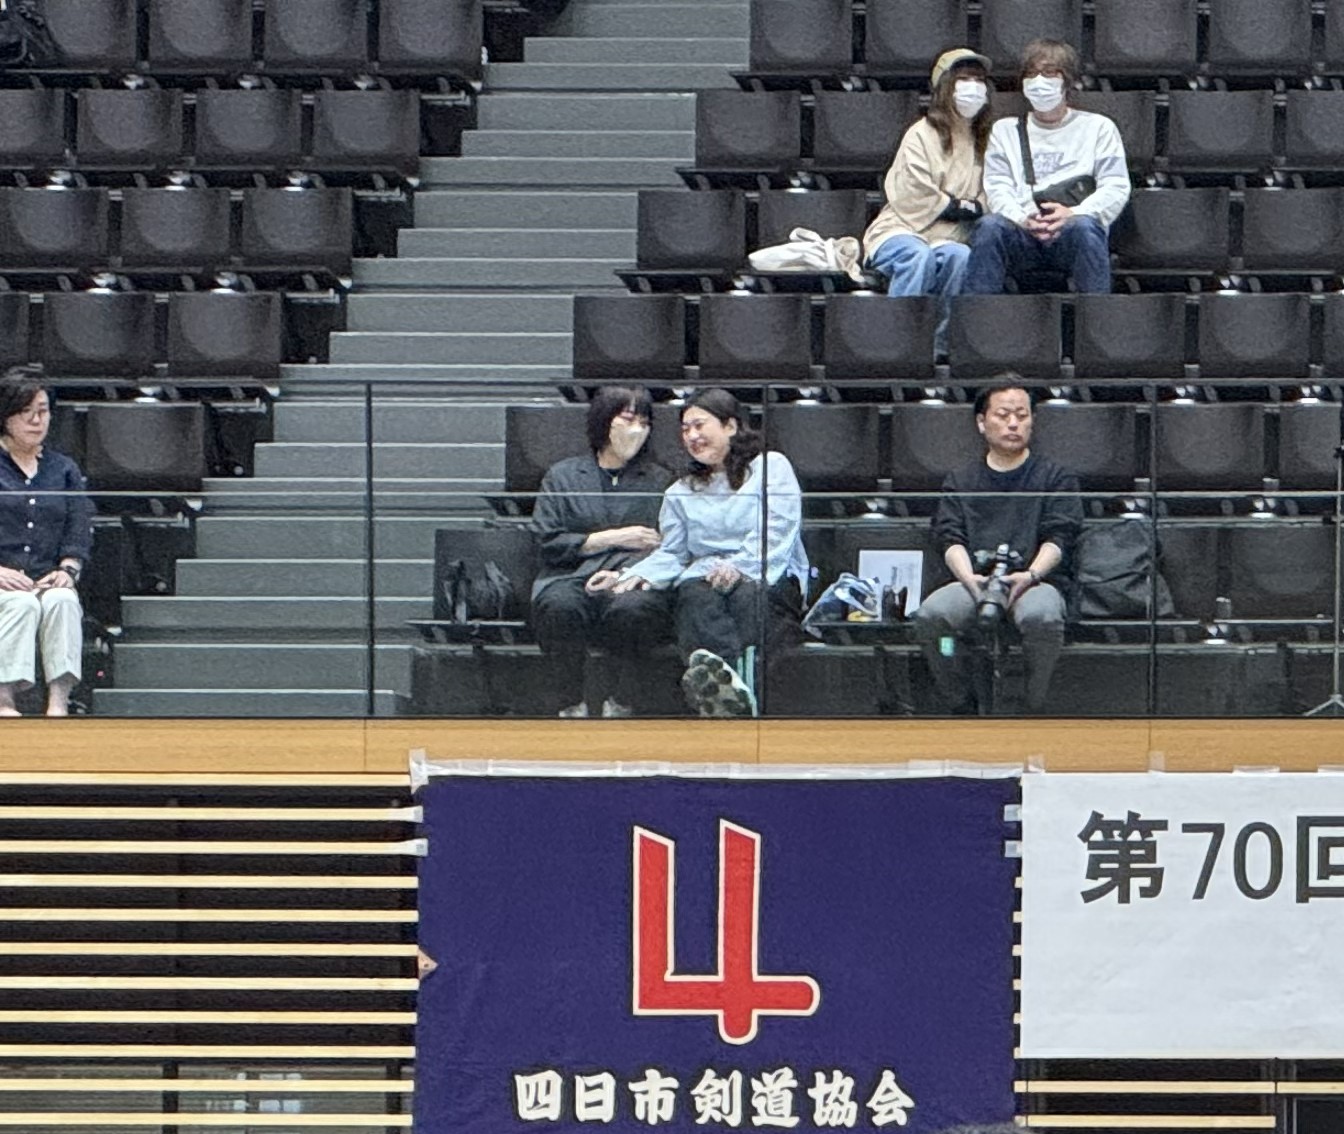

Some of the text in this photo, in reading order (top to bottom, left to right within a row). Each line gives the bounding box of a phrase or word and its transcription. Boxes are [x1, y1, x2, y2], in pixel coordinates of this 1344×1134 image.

[514, 1067, 916, 1129] 四日市剣道協会
